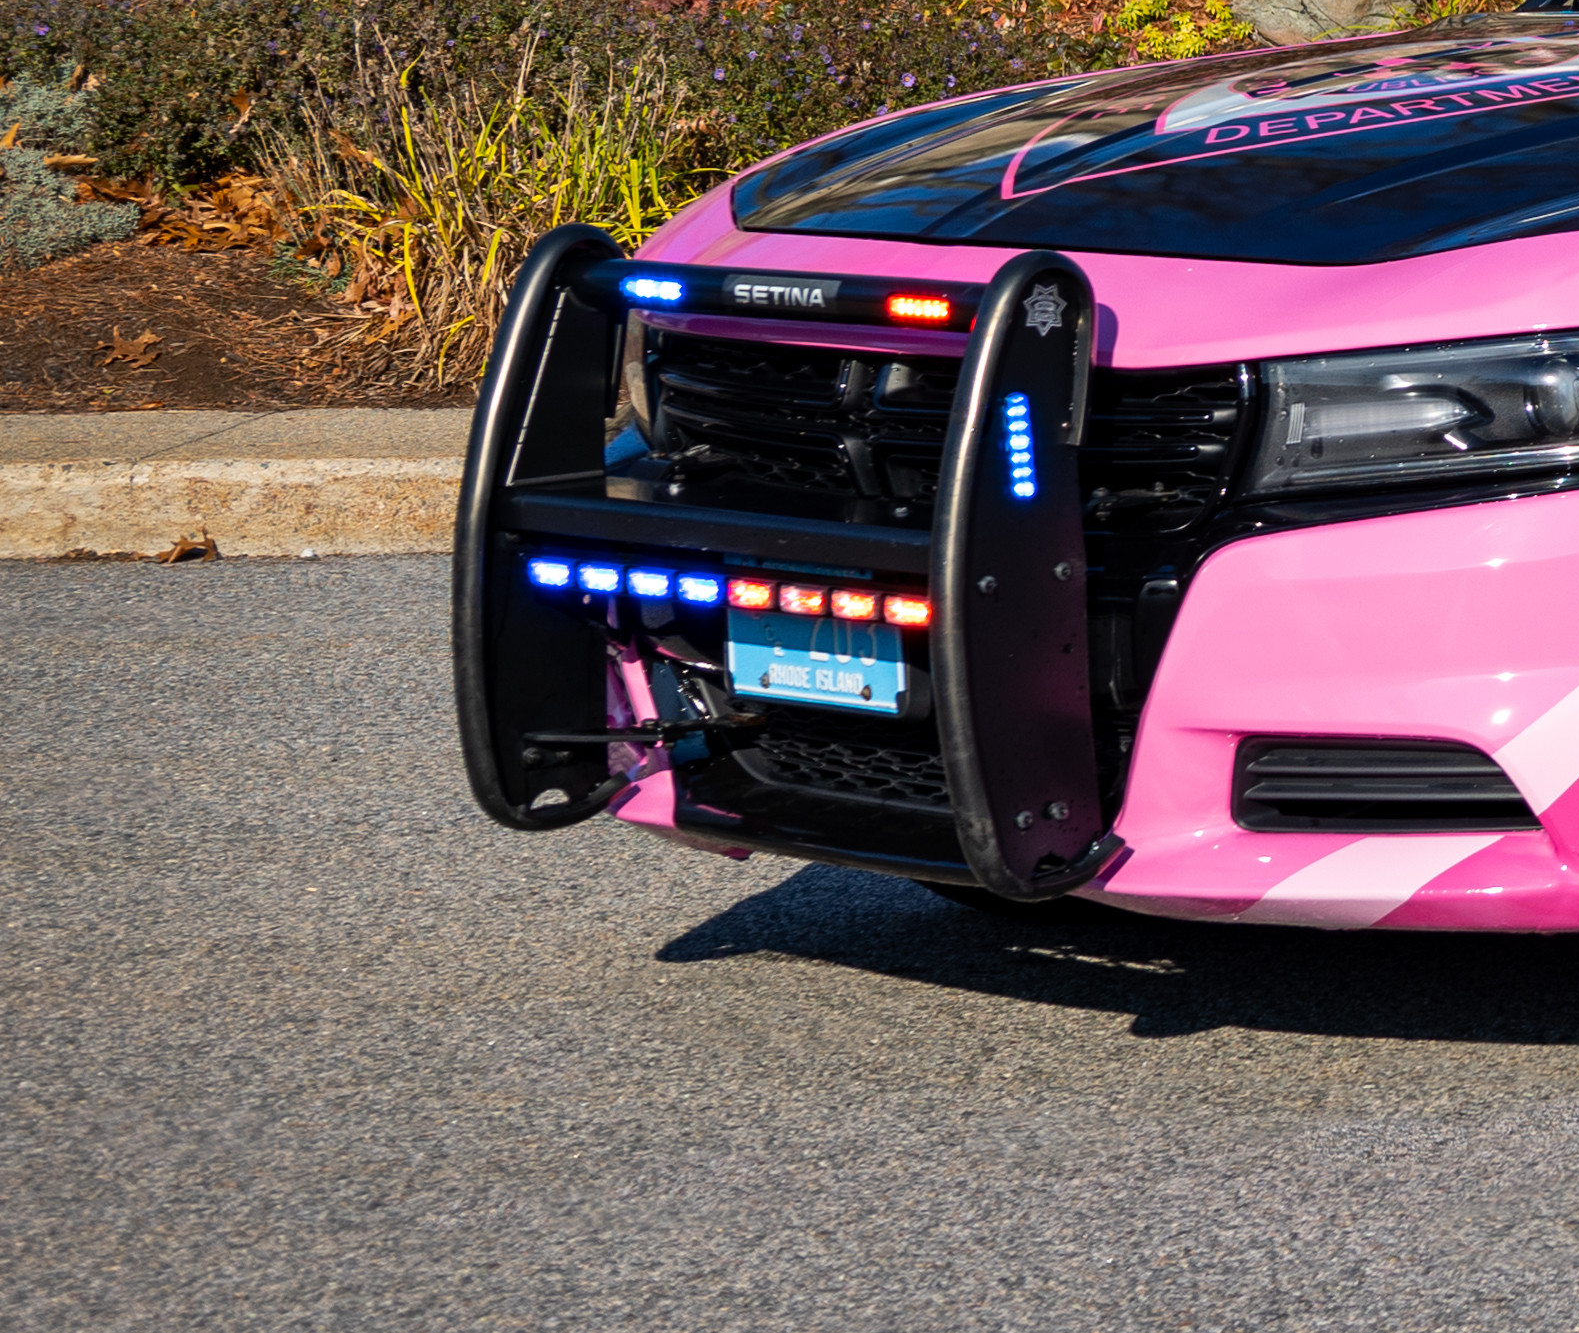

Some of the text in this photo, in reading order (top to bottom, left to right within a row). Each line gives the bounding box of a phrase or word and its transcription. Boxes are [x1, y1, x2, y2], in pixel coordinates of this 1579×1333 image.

[734, 283, 826, 308] SETINA
[768, 663, 864, 695] RHODE ISLAND
